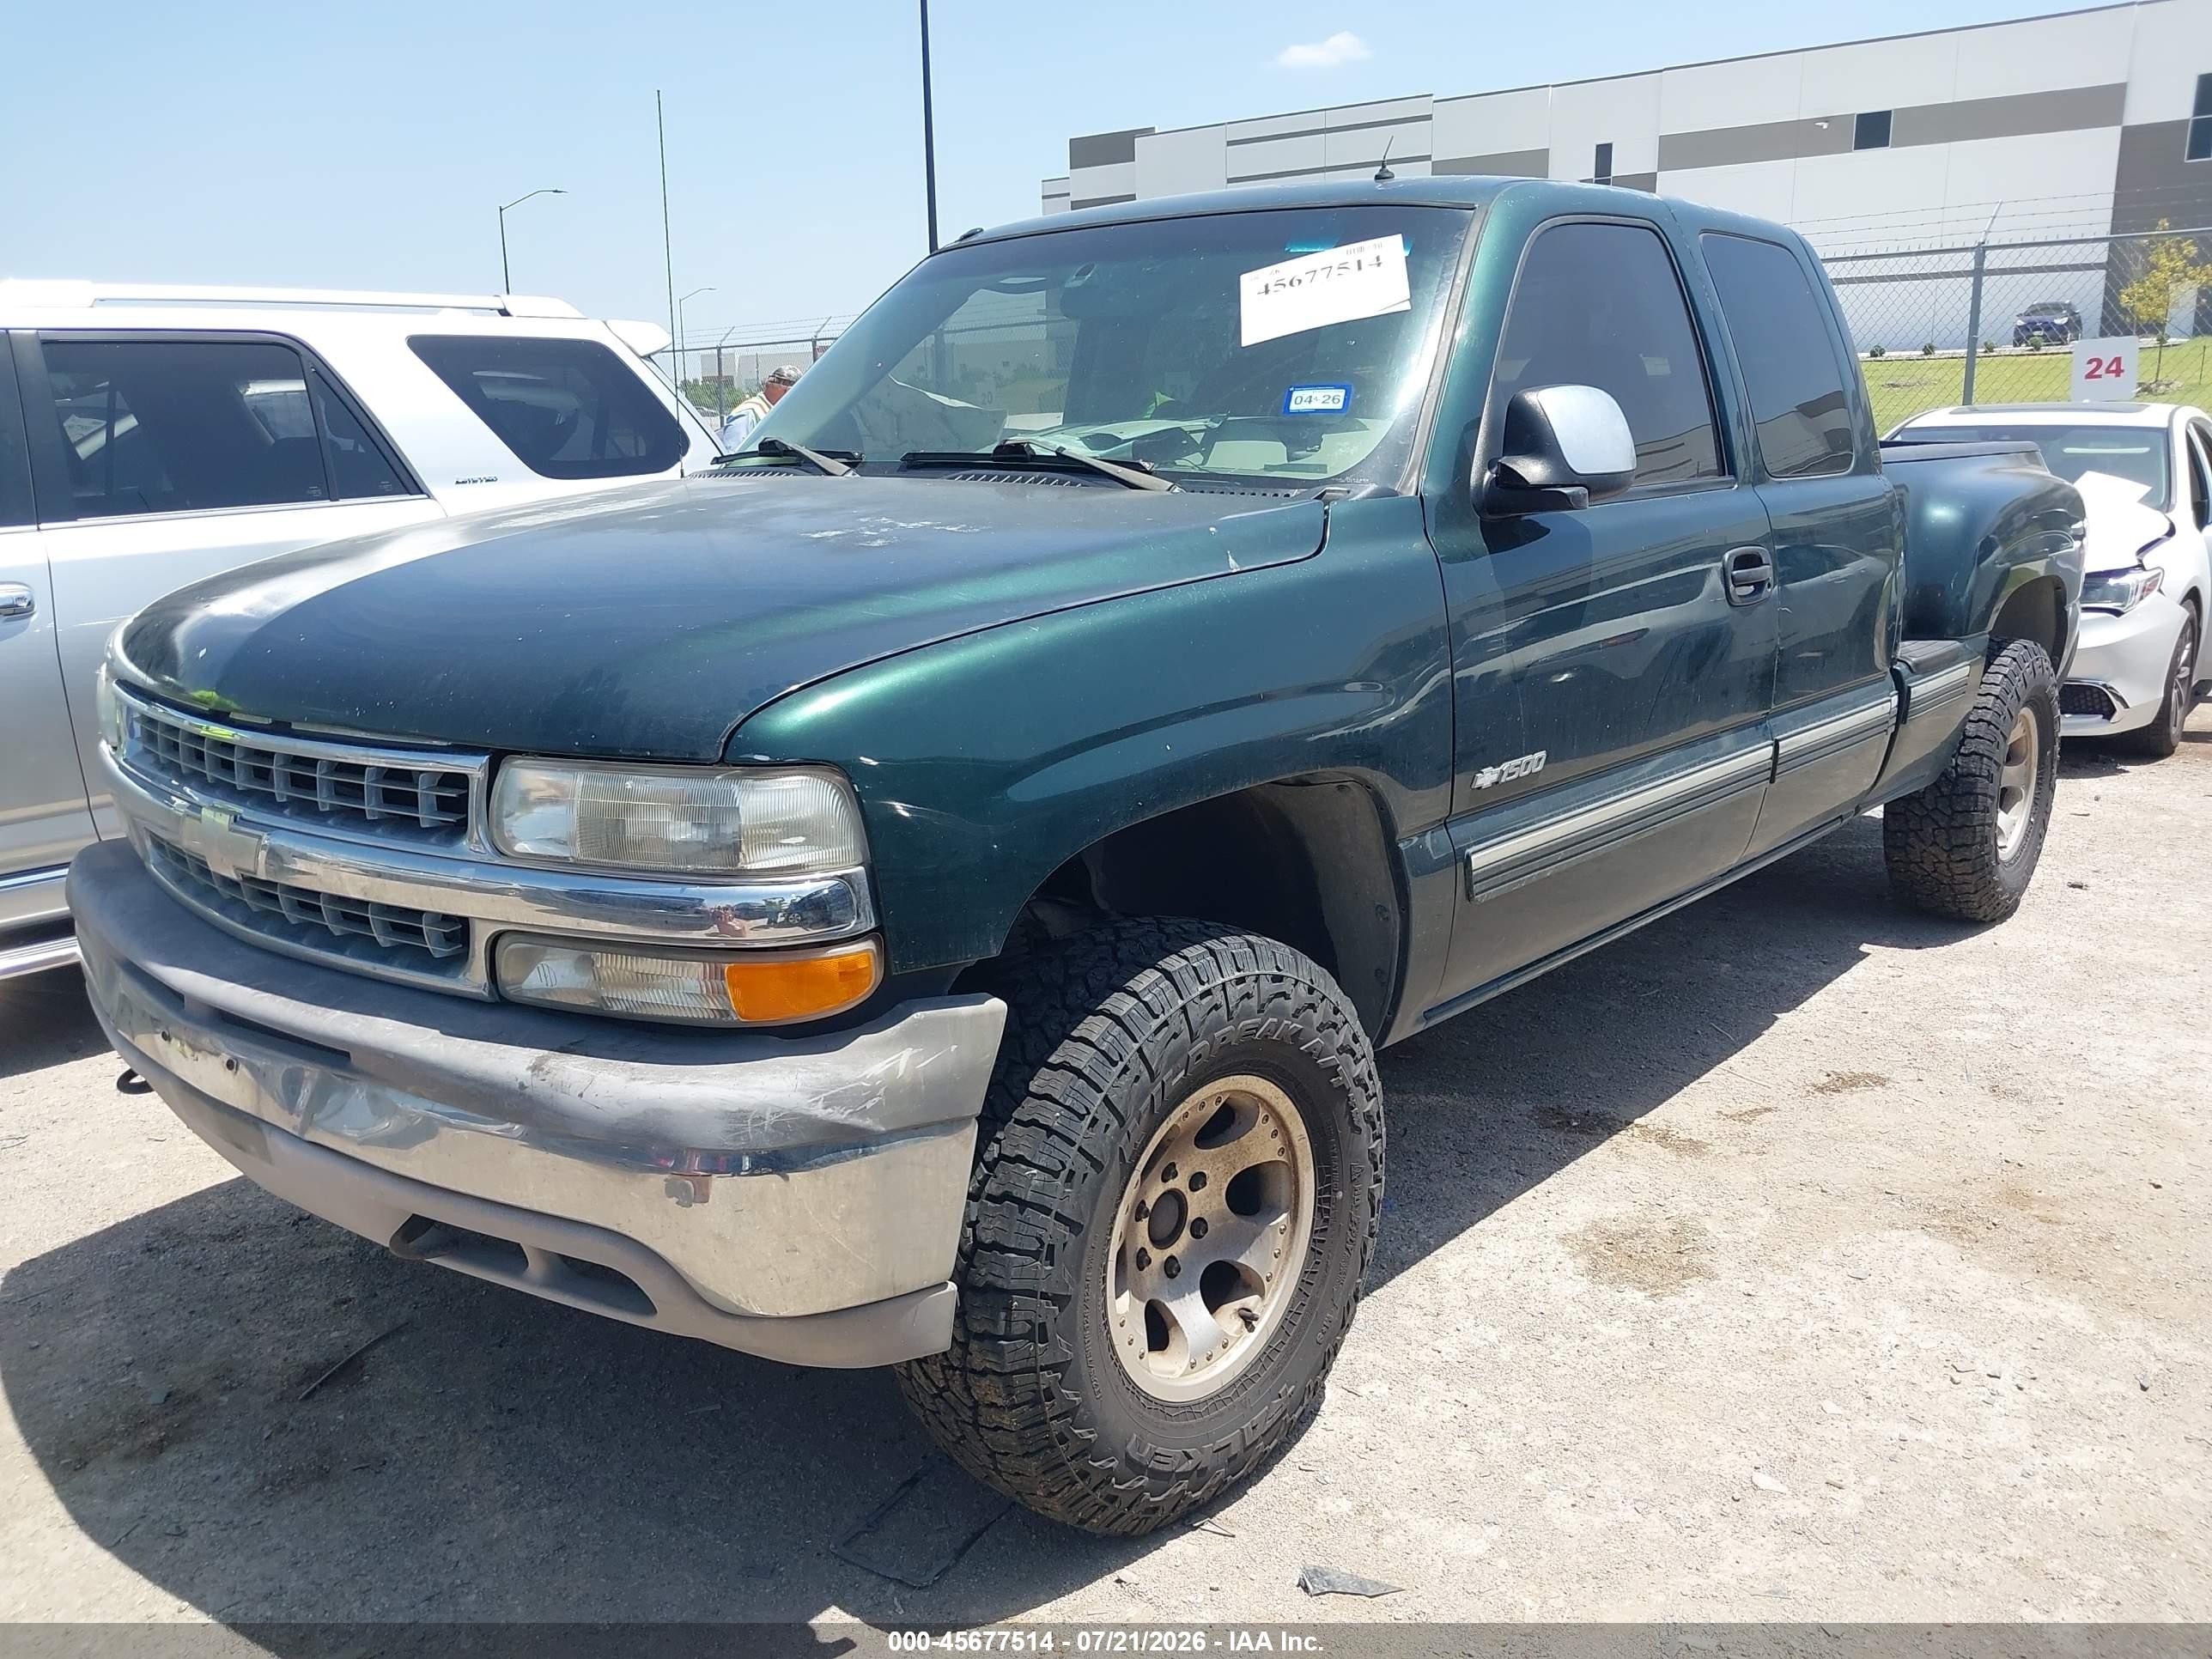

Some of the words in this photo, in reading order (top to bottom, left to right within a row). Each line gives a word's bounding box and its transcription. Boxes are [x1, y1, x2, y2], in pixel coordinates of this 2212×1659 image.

[1257, 255, 1383, 295] 45677514
[2084, 356, 2125, 380] 24
[1498, 750, 1547, 783] 1500
